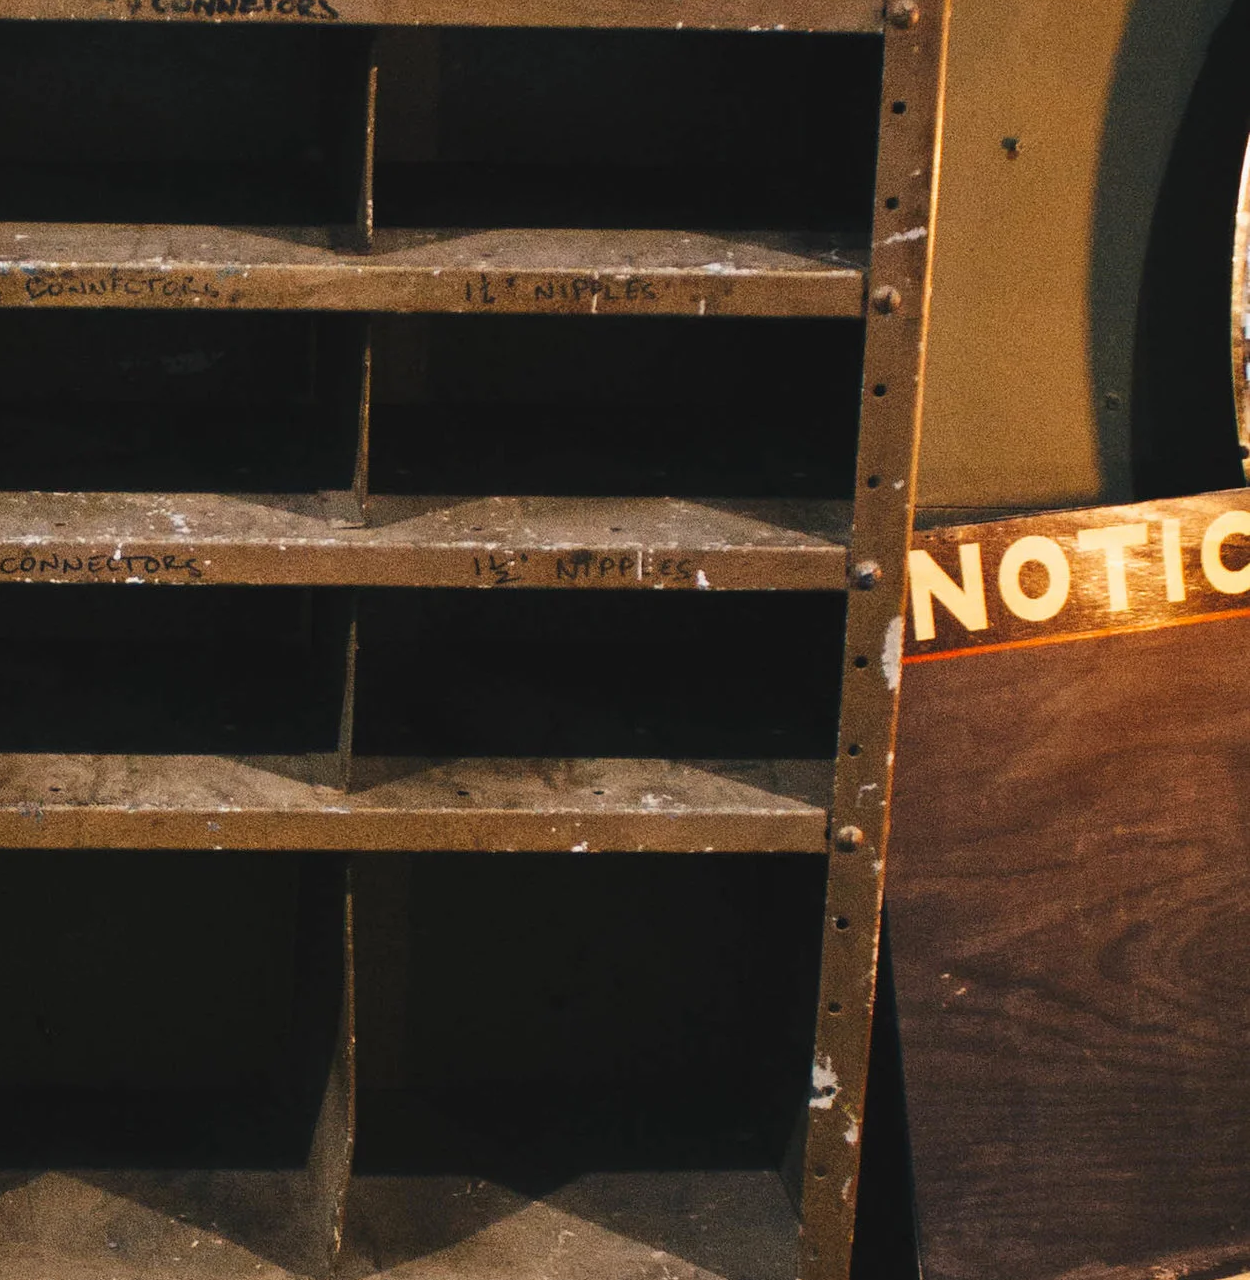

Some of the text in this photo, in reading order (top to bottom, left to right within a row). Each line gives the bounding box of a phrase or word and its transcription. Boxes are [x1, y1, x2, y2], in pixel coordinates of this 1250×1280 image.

[535, 278, 657, 301] NIPPLES
[0, 553, 203, 578] CONNECTORS
[908, 509, 1250, 642] NOTIC
